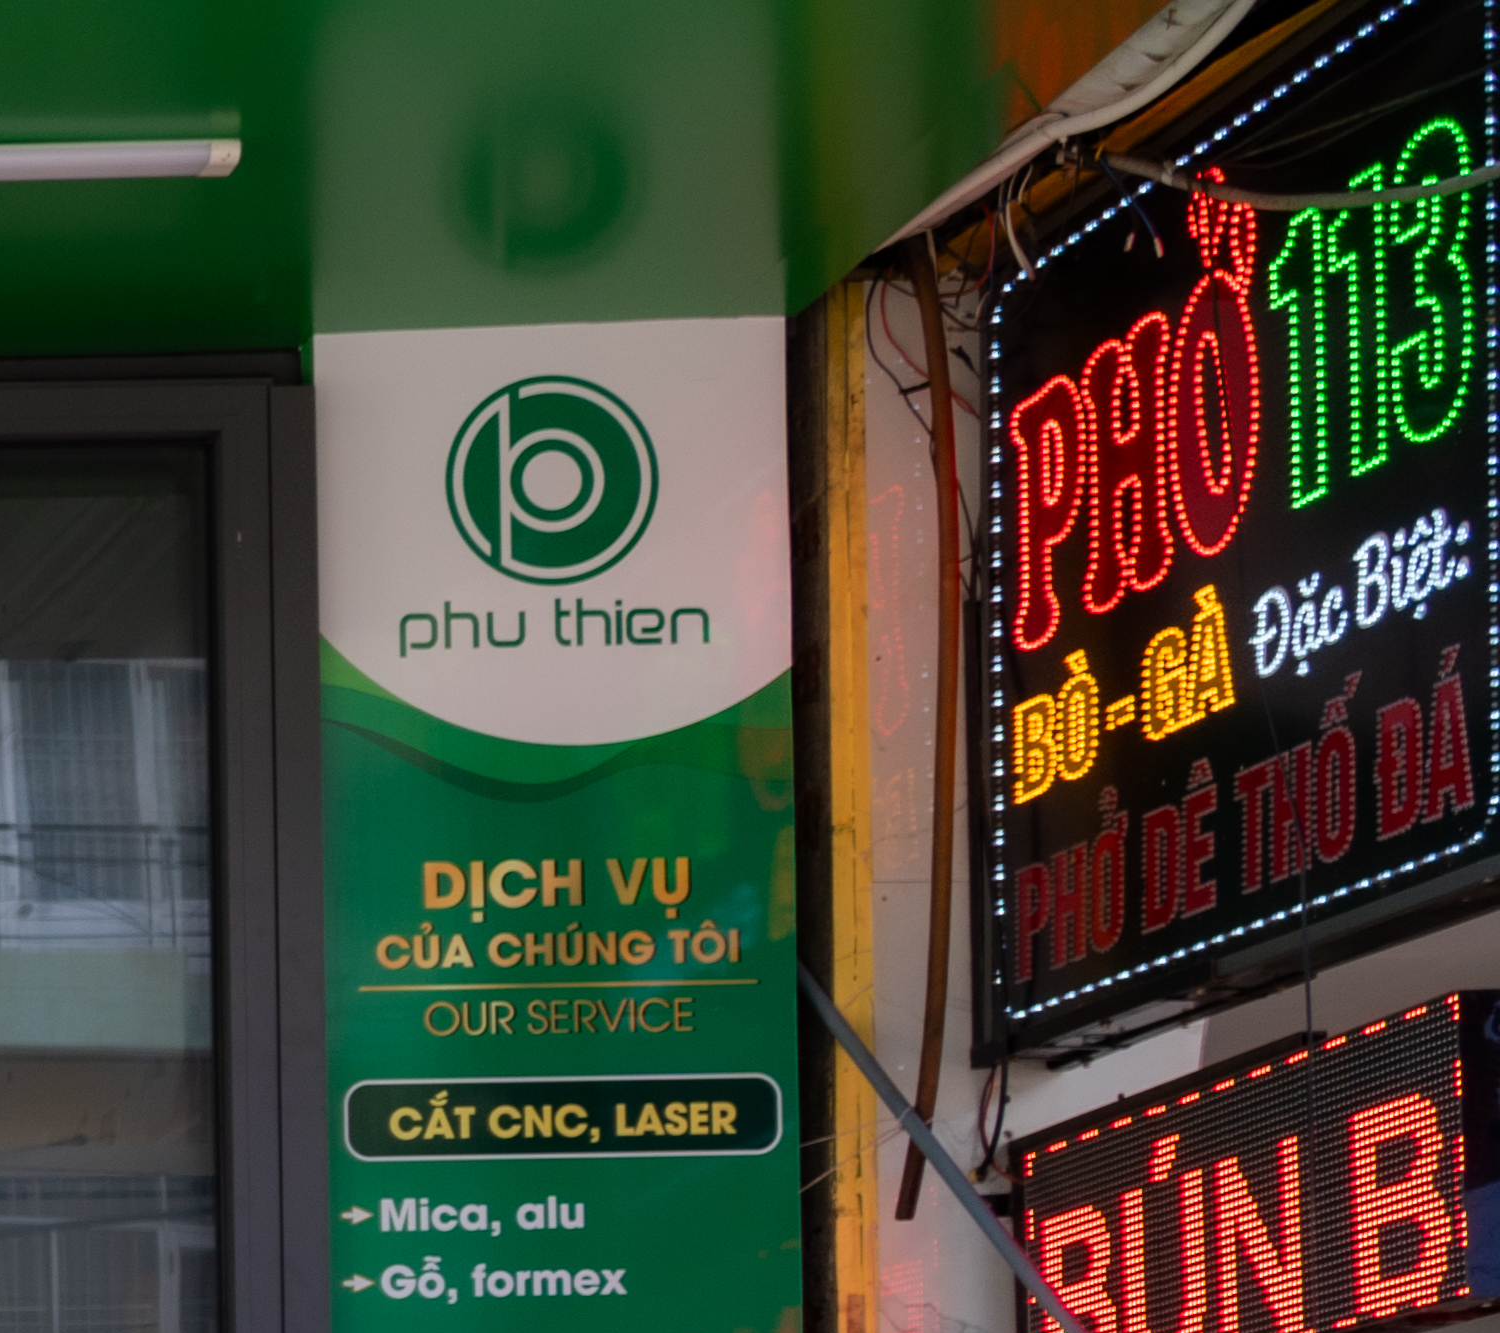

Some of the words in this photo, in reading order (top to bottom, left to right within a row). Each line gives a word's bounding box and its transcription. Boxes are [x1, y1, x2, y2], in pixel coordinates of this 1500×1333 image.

[1011, 166, 1261, 652] PHỞ
[1268, 116, 1472, 510] 113
[399, 601, 526, 657] phu
[554, 598, 710, 646] thien
[1249, 572, 1347, 677] Đặc
[1014, 786, 1128, 985] PHỞ
[1142, 757, 1216, 935] DÊ
[1235, 671, 1362, 895] THỐ
[1374, 644, 1475, 841] ĐÁ
[423, 859, 583, 922] DỊCH
[606, 857, 690, 918] VỤ
[377, 923, 474, 969] CỦA
[488, 923, 655, 966] CHÚNG
[669, 920, 740, 963] TÔI
[424, 1001, 515, 1036] OUR
[527, 997, 694, 1034] SERVICE
[390, 1091, 476, 1140] CẮT
[489, 1104, 600, 1143] CNC,
[615, 1102, 736, 1137] LASER
[380, 1198, 501, 1236] Mica,
[516, 1196, 585, 1230] alu
[381, 1256, 457, 1304] Gỗ,
[472, 1264, 627, 1298] formex
